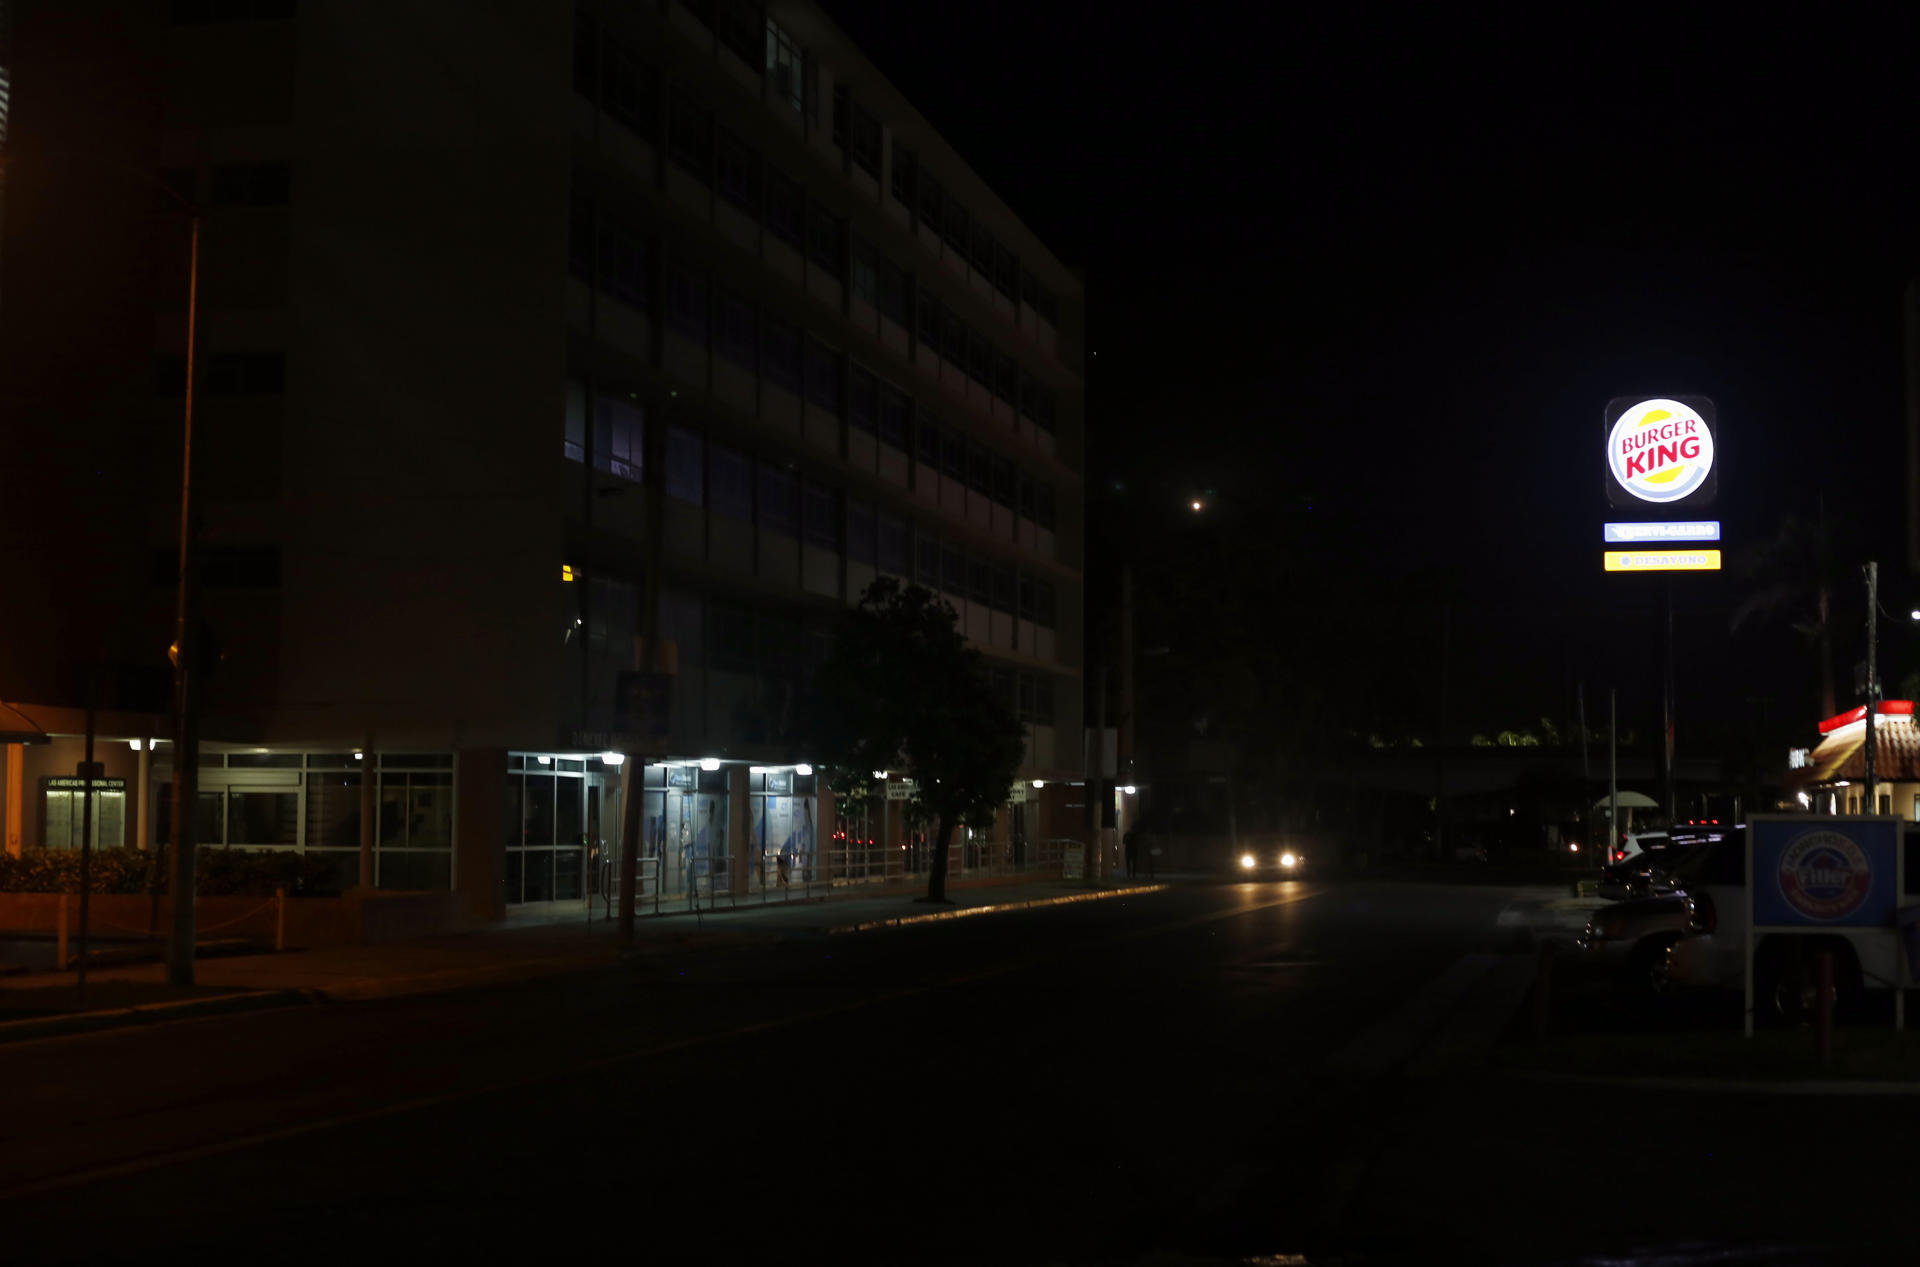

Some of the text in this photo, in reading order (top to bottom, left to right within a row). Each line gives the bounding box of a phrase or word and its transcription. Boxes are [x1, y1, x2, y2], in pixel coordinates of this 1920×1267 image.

[1622, 419, 1696, 455] BURGER
[1626, 436, 1700, 480] KING
[1635, 555, 1707, 565] DESAYUNO
